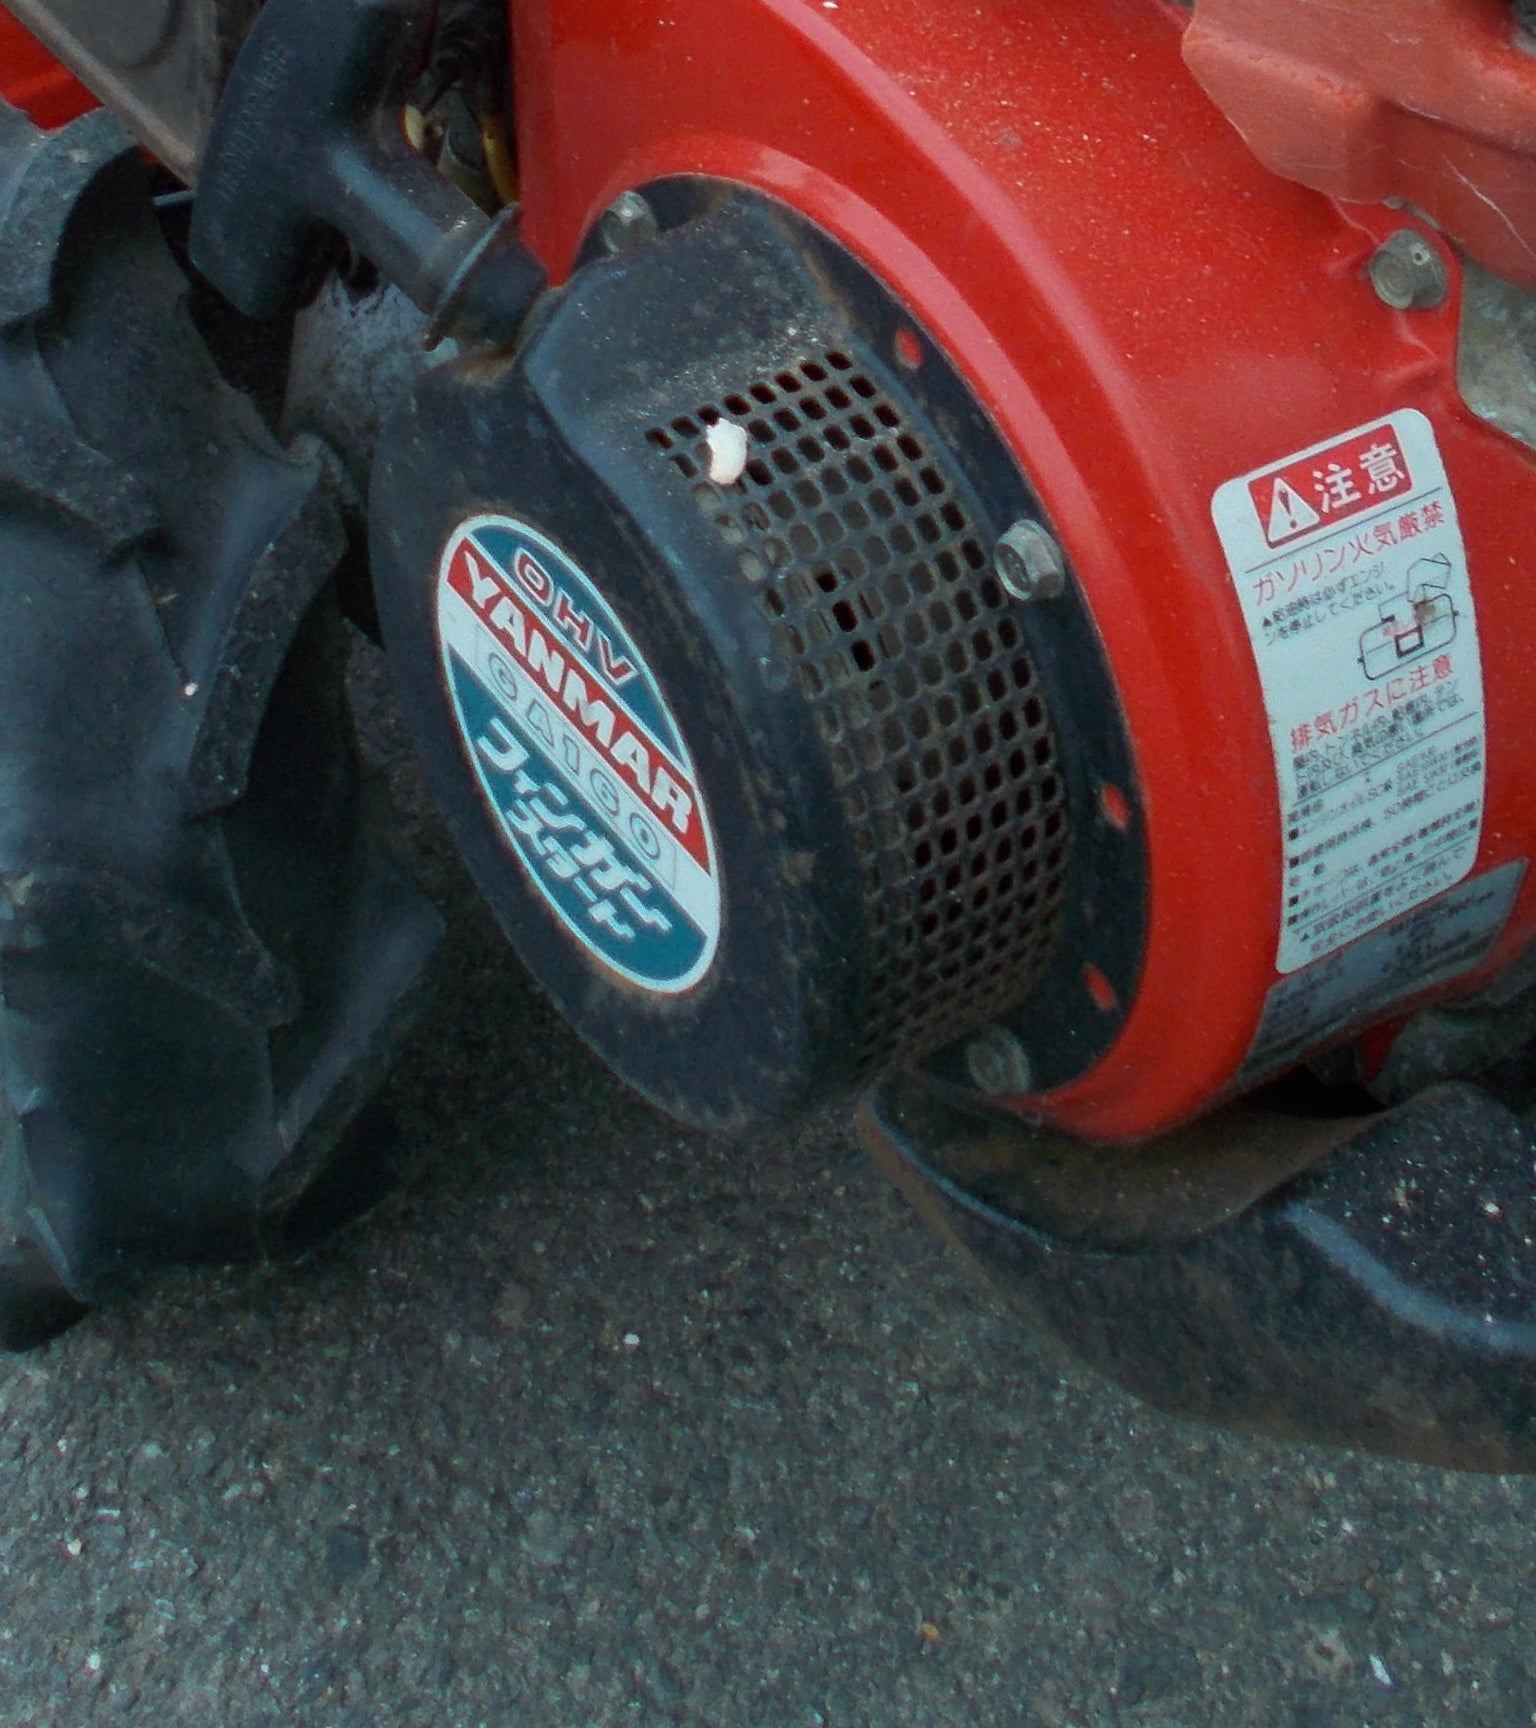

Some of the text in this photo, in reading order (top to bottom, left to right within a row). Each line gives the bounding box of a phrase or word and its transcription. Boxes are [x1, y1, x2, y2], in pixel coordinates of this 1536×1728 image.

[1314, 443, 1405, 515] 注意
[1251, 499, 1446, 607] ガソリン火気厳禁
[512, 546, 640, 686] OHV
[463, 548, 695, 835] YANMAR
[1290, 654, 1454, 751] 排気ガスに注意
[485, 651, 662, 862] GA160
